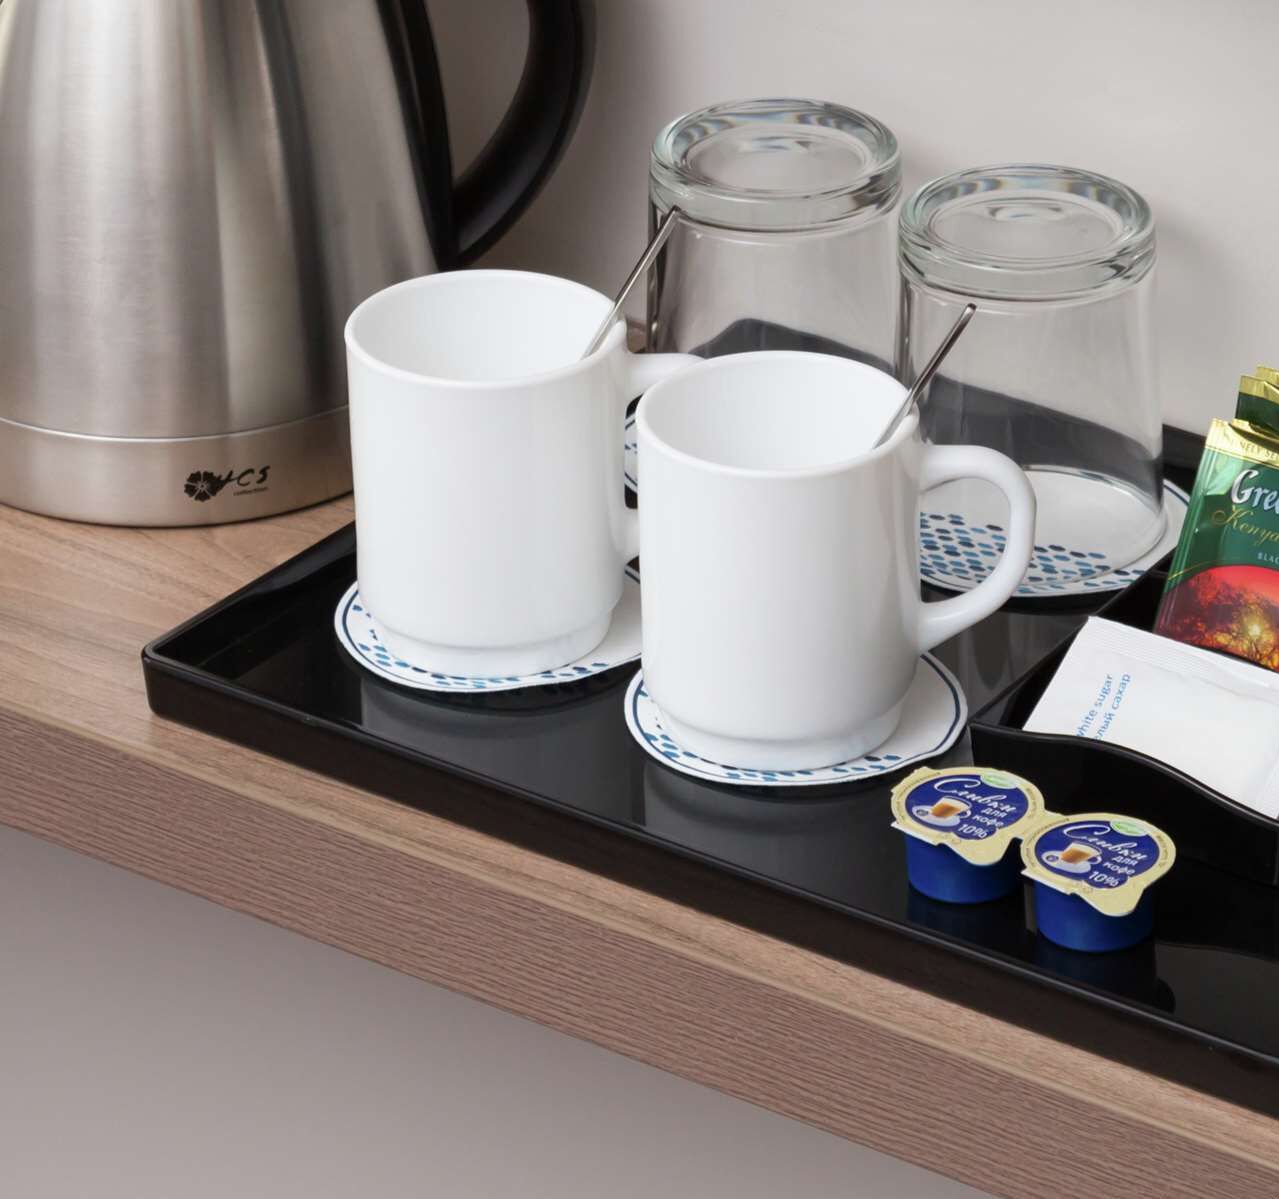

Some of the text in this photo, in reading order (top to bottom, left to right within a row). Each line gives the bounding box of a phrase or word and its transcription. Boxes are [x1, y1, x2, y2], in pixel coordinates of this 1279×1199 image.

[1094, 674, 1113, 707] sugar
[1112, 673, 1131, 710] сахар
[972, 814, 1004, 828] кофе
[958, 823, 988, 839] 10%
[1103, 861, 1135, 876] кофе
[1088, 871, 1120, 888] 10%
